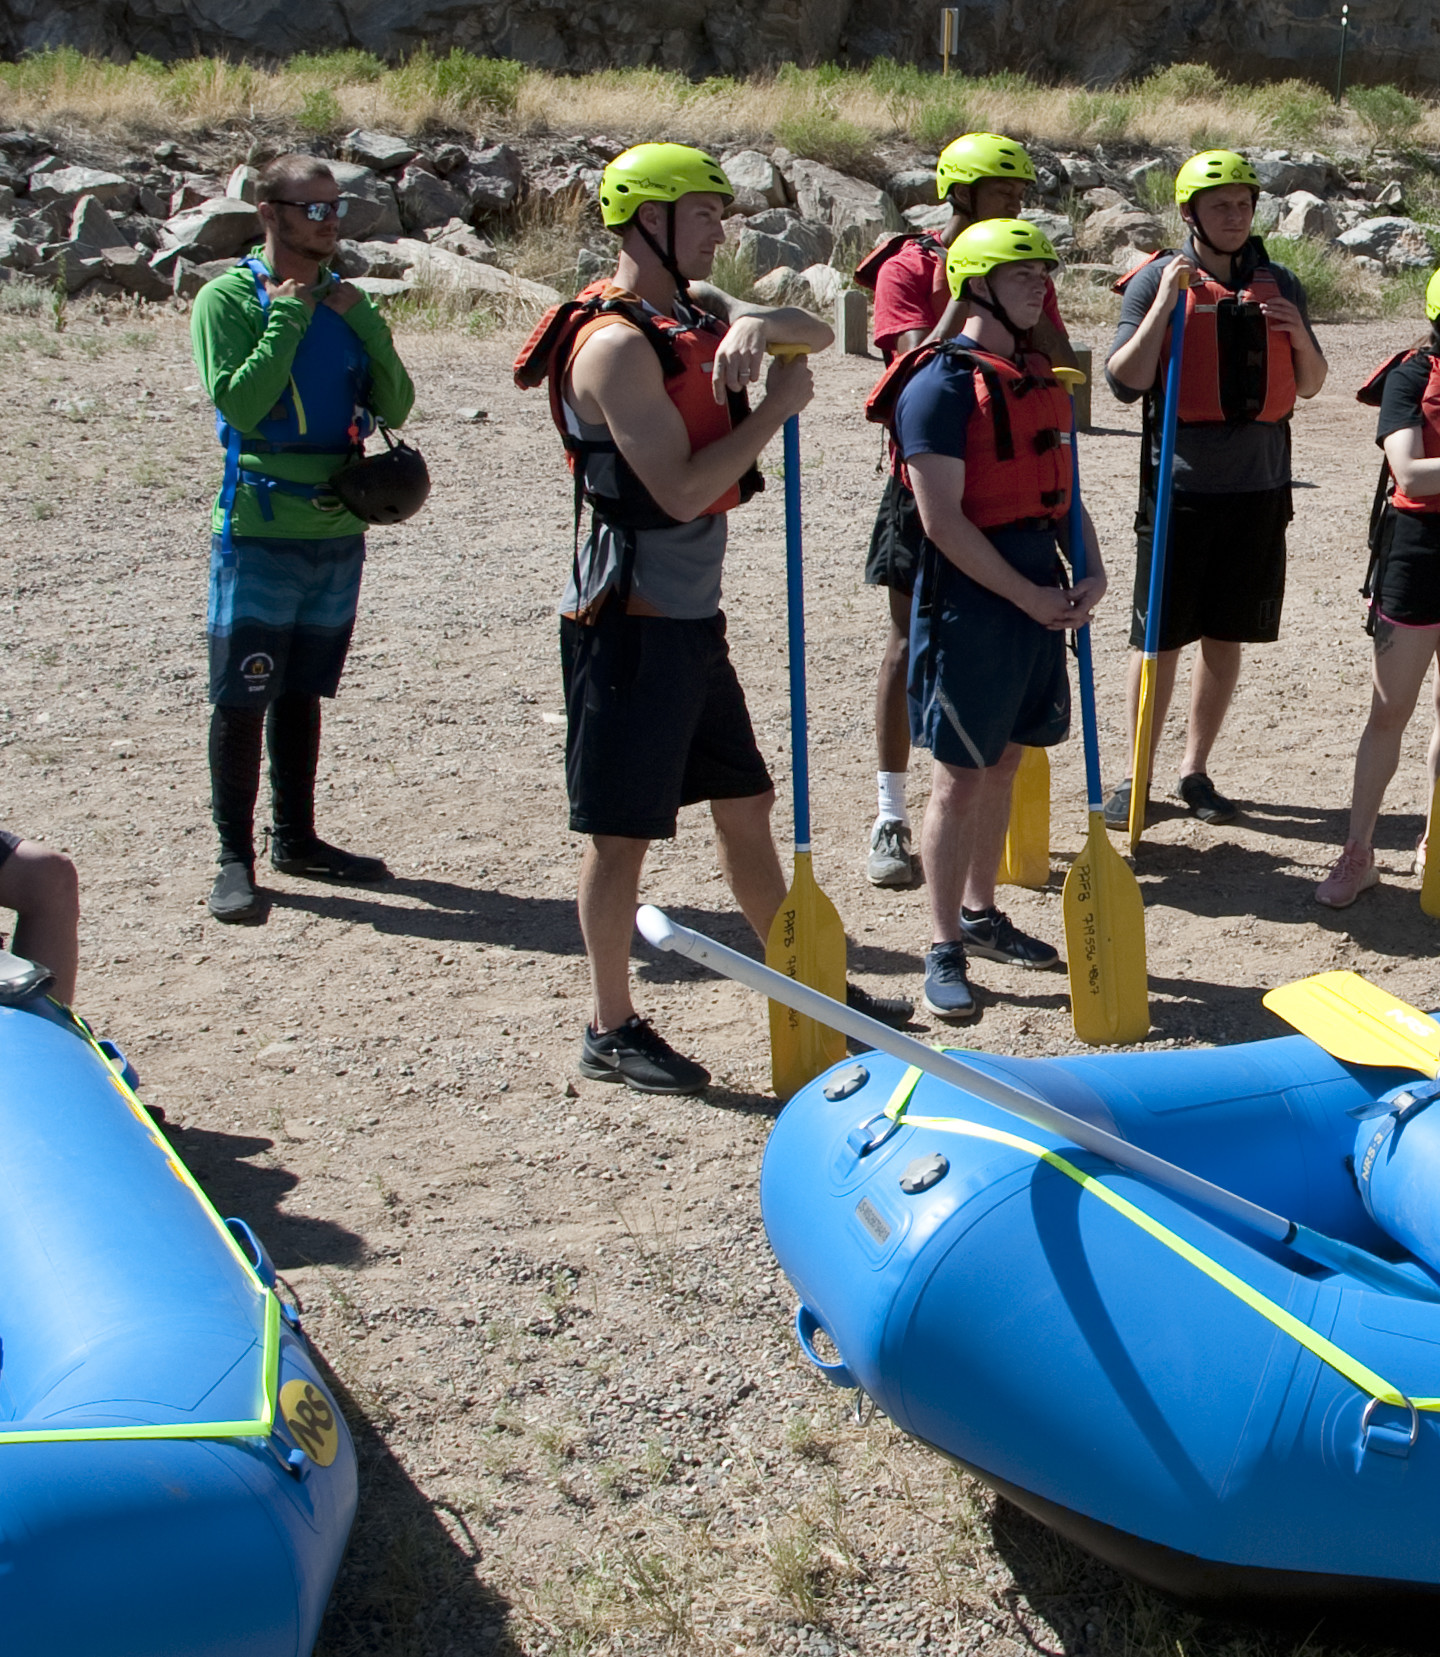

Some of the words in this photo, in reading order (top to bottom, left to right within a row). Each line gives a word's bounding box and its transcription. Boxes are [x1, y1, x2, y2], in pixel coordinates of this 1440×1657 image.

[1077, 864, 1091, 902] PAFB
[784, 909, 796, 949] PAFB
[288, 1384, 334, 1460] NRS
